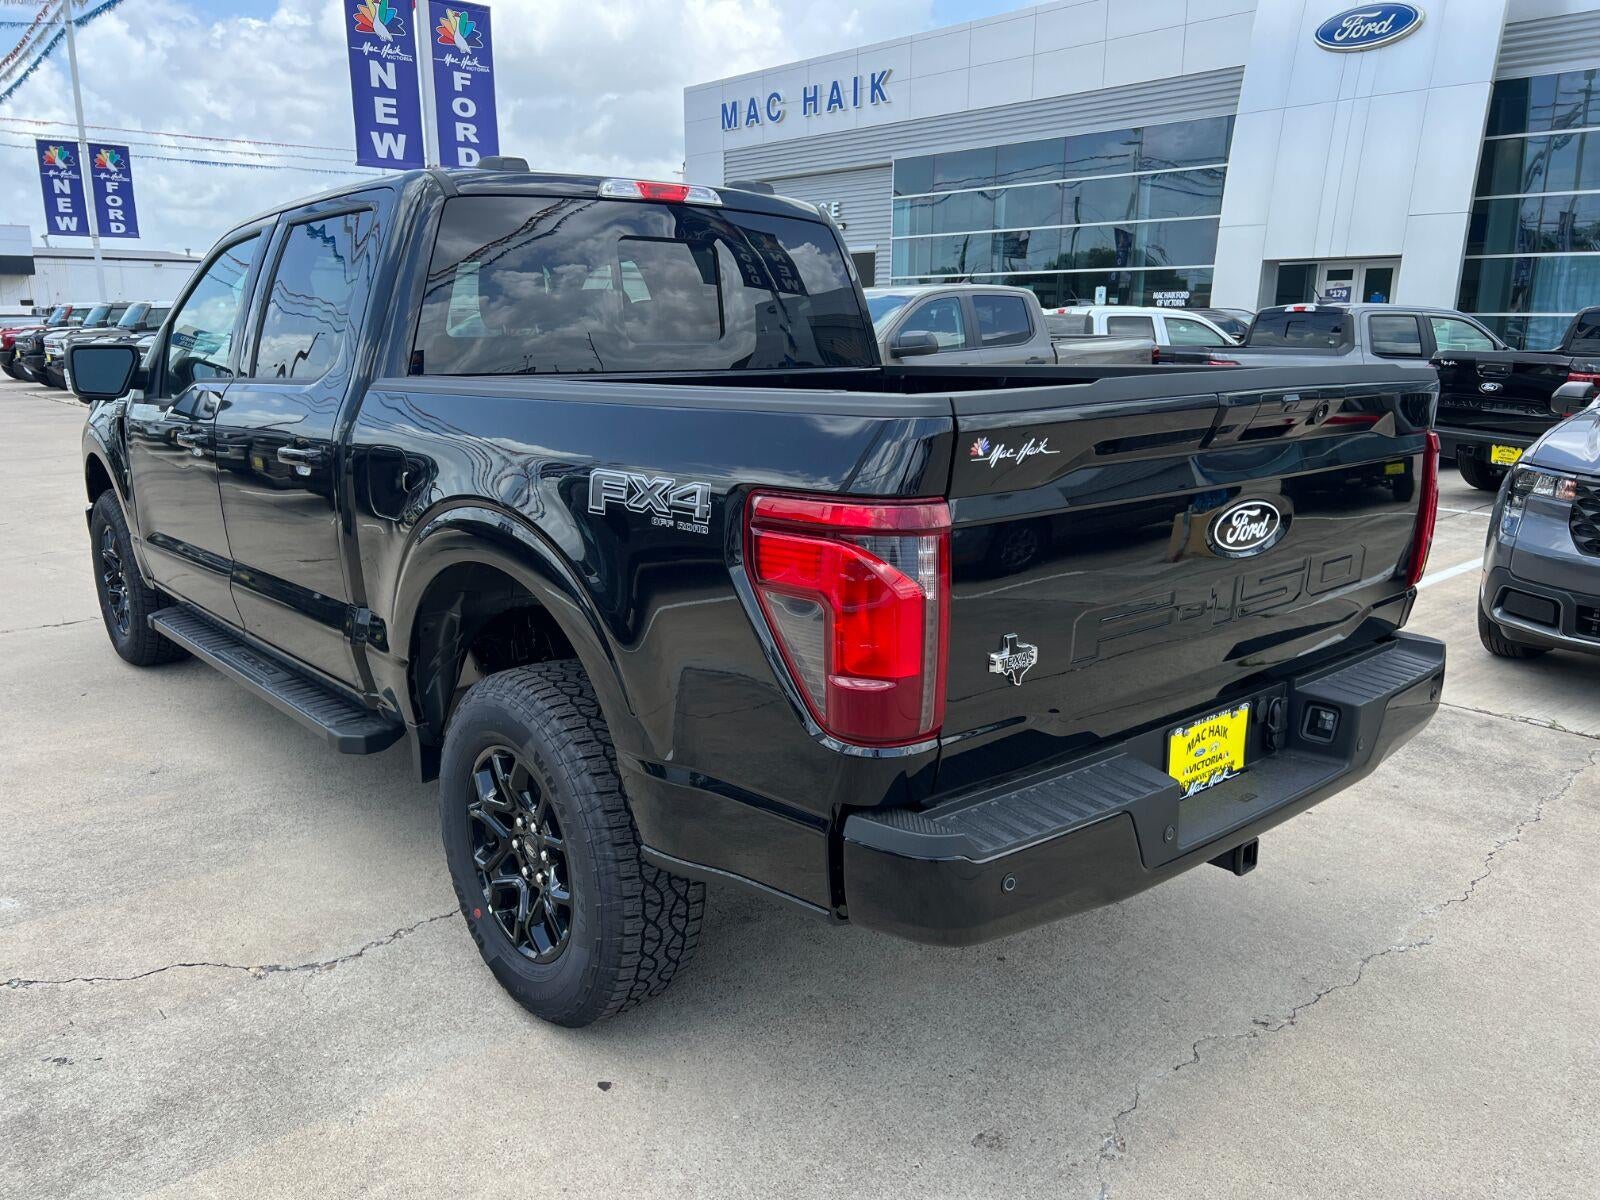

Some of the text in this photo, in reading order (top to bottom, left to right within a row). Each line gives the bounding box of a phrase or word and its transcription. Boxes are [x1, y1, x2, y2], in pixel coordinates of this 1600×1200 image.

[1334, 11, 1396, 41] Ford
[351, 41, 412, 58] Mac Haik
[434, 53, 490, 69] Mac Haik
[369, 59, 407, 160] NEW
[721, 68, 891, 131] MAC HAIK
[451, 71, 480, 167] FORD
[52, 178, 78, 232] NEW
[105, 181, 127, 233] FORD
[970, 437, 1061, 469] Mac Haik
[588, 467, 712, 525] FX4
[651, 516, 709, 535] OFF ROAD
[1226, 508, 1271, 544] Ford
[1070, 544, 1367, 665] F-150
[1001, 650, 1035, 670] TEXAS
[1186, 728, 1207, 755] MAC
[1208, 724, 1229, 739] HAIK
[1188, 752, 1223, 774] VICTORIA
[1180, 781, 1209, 800] Mac
